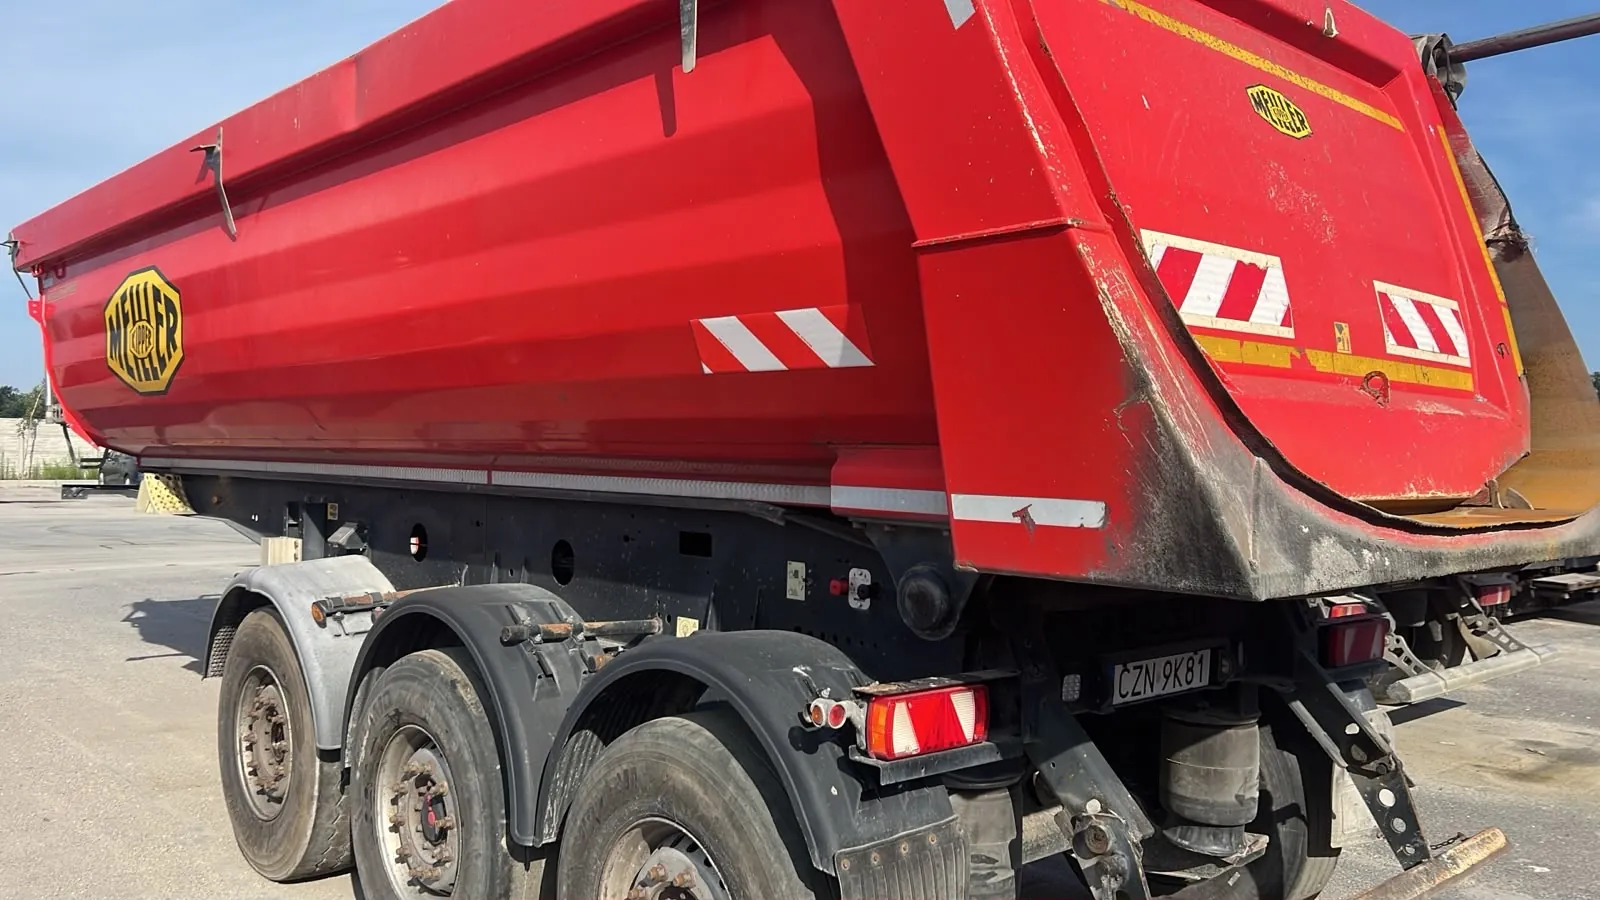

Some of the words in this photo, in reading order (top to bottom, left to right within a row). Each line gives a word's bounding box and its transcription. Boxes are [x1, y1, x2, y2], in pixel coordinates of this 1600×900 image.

[1250, 90, 1308, 133] MEILLER
[108, 281, 178, 382] MEILLER
[1118, 662, 1156, 699] CZN
[1162, 654, 1204, 691] 9K81
